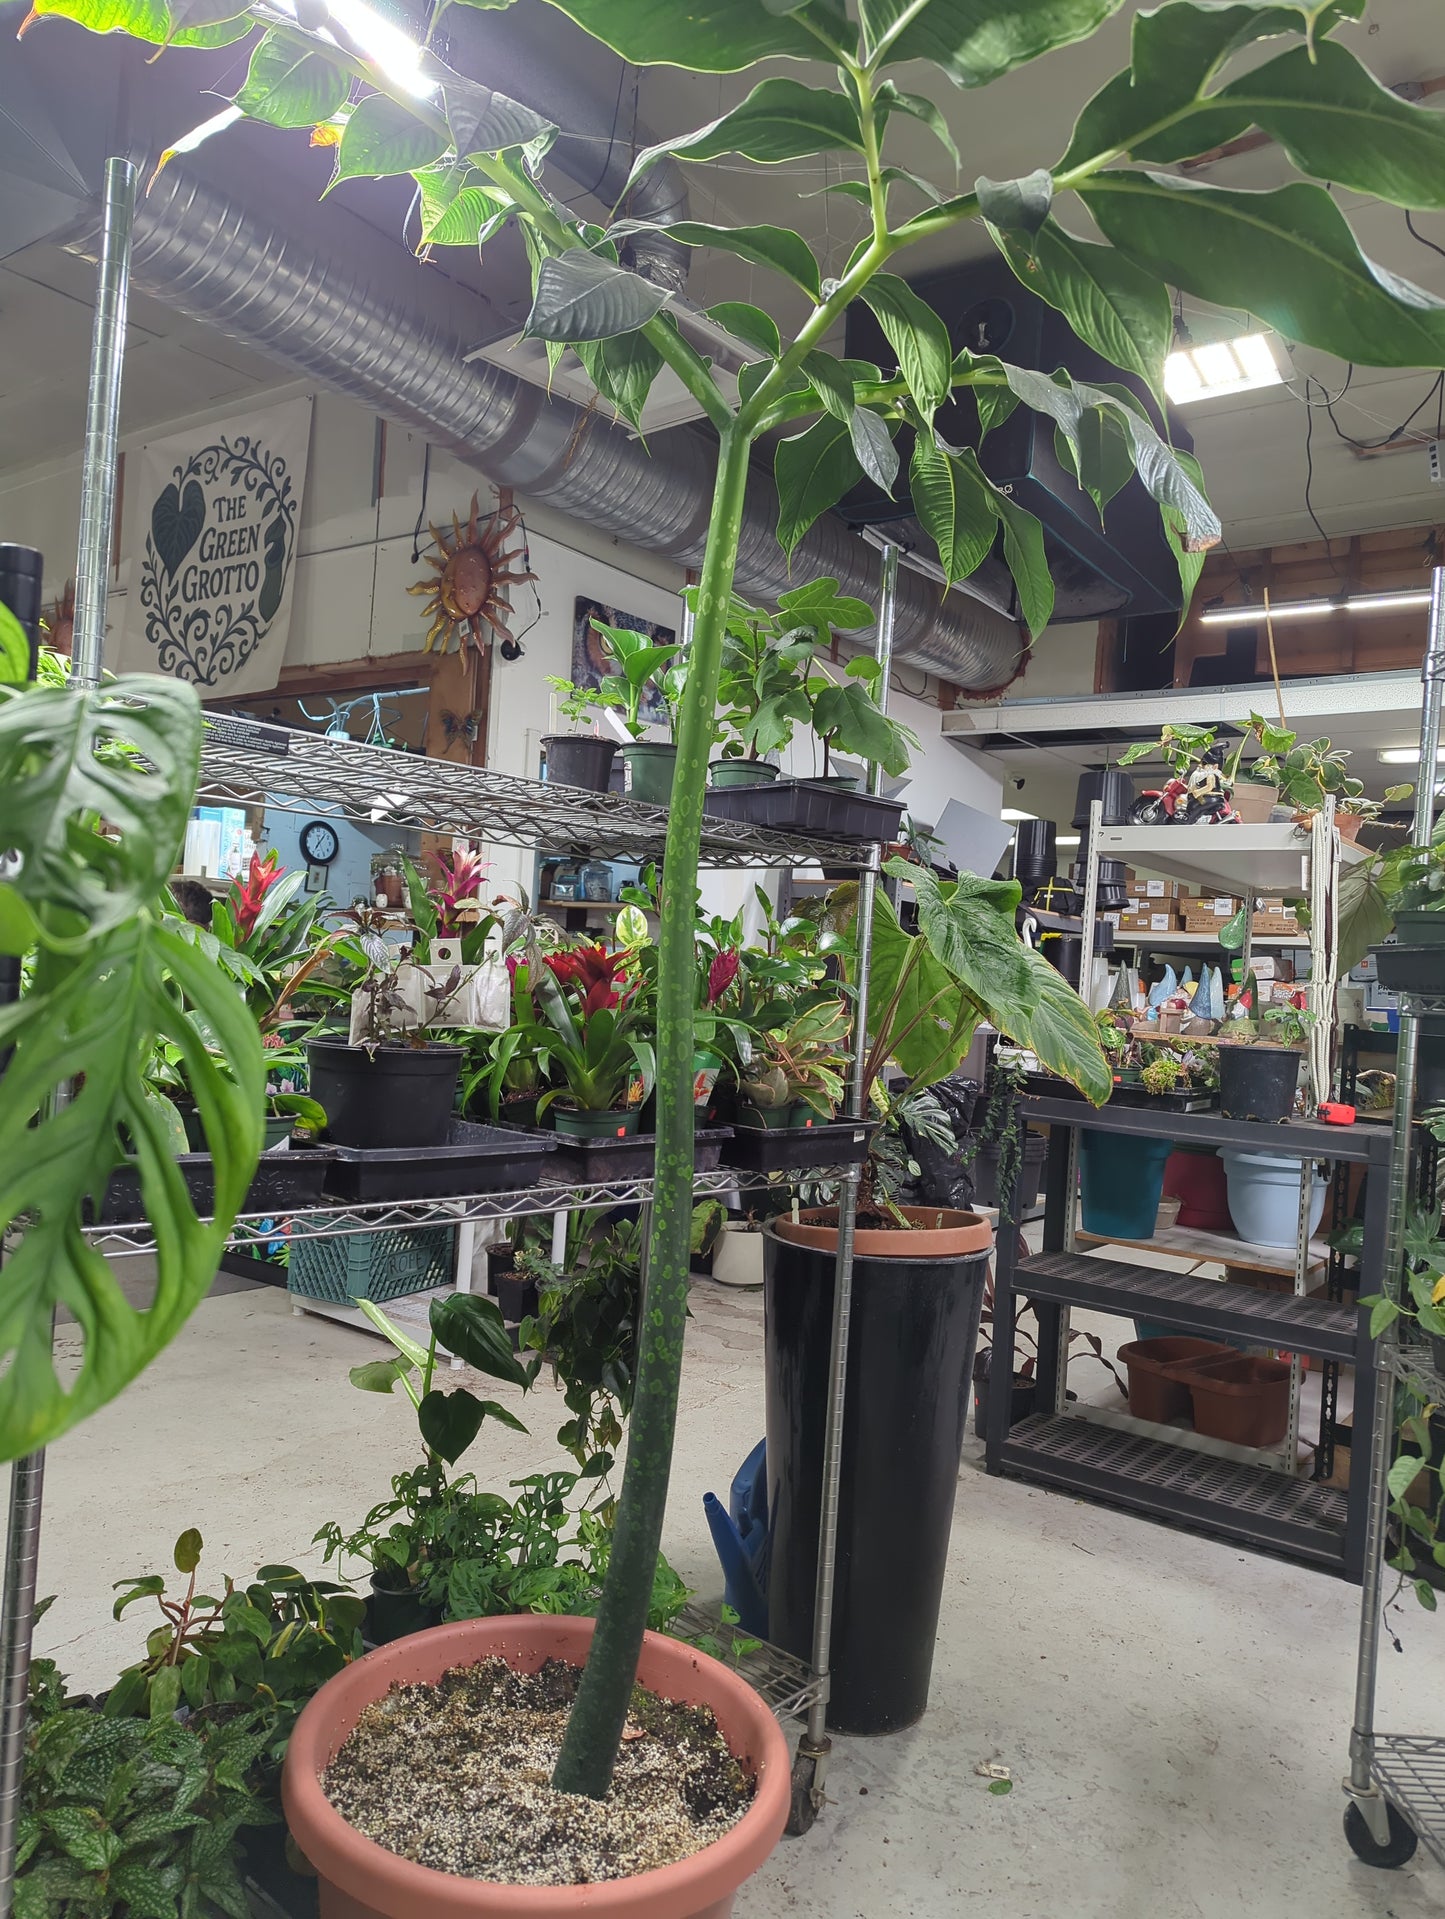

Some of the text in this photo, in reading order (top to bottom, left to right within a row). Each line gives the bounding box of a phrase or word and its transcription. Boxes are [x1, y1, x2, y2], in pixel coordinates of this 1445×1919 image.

[212, 495, 247, 523] THE
[199, 523, 261, 563] GREEN
[182, 560, 259, 603] GROTTO
[388, 1250, 425, 1275] ROPE
